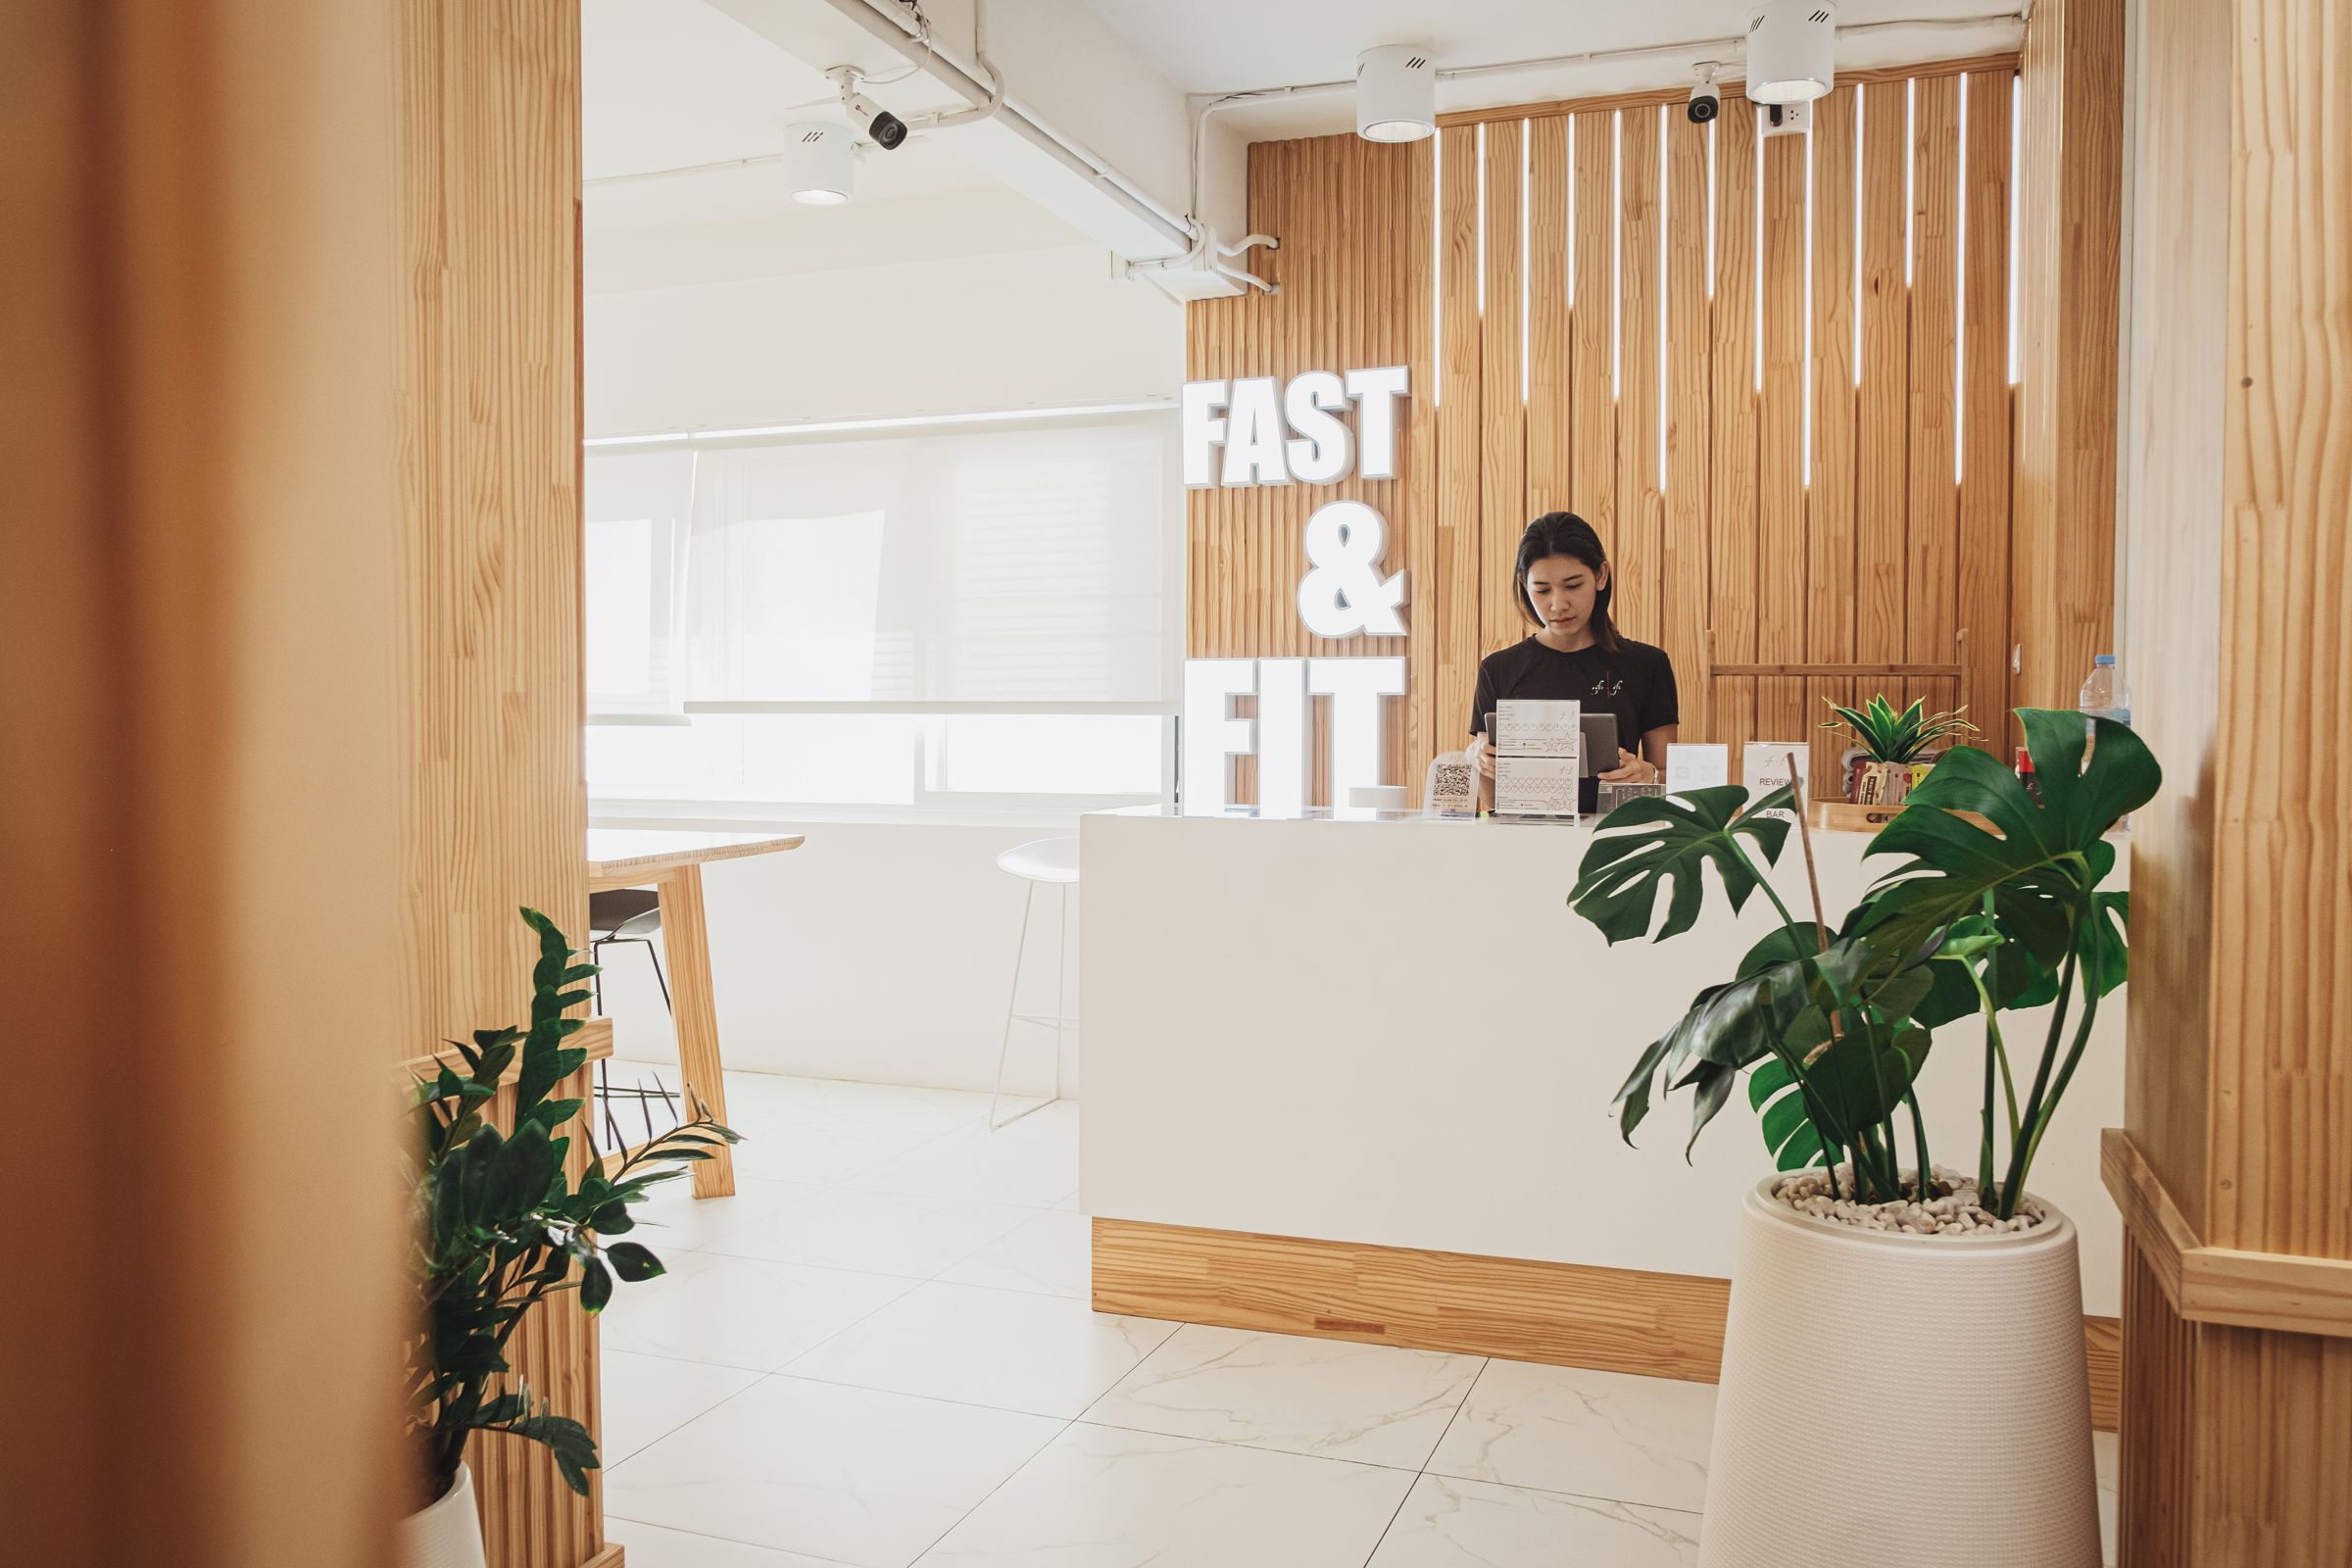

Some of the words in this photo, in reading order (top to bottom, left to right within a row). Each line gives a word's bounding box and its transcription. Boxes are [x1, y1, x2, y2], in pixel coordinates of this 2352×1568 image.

[1182, 366, 1411, 488] FAST
[1298, 500, 1411, 639] &
[1184, 657, 1410, 820] FIT
